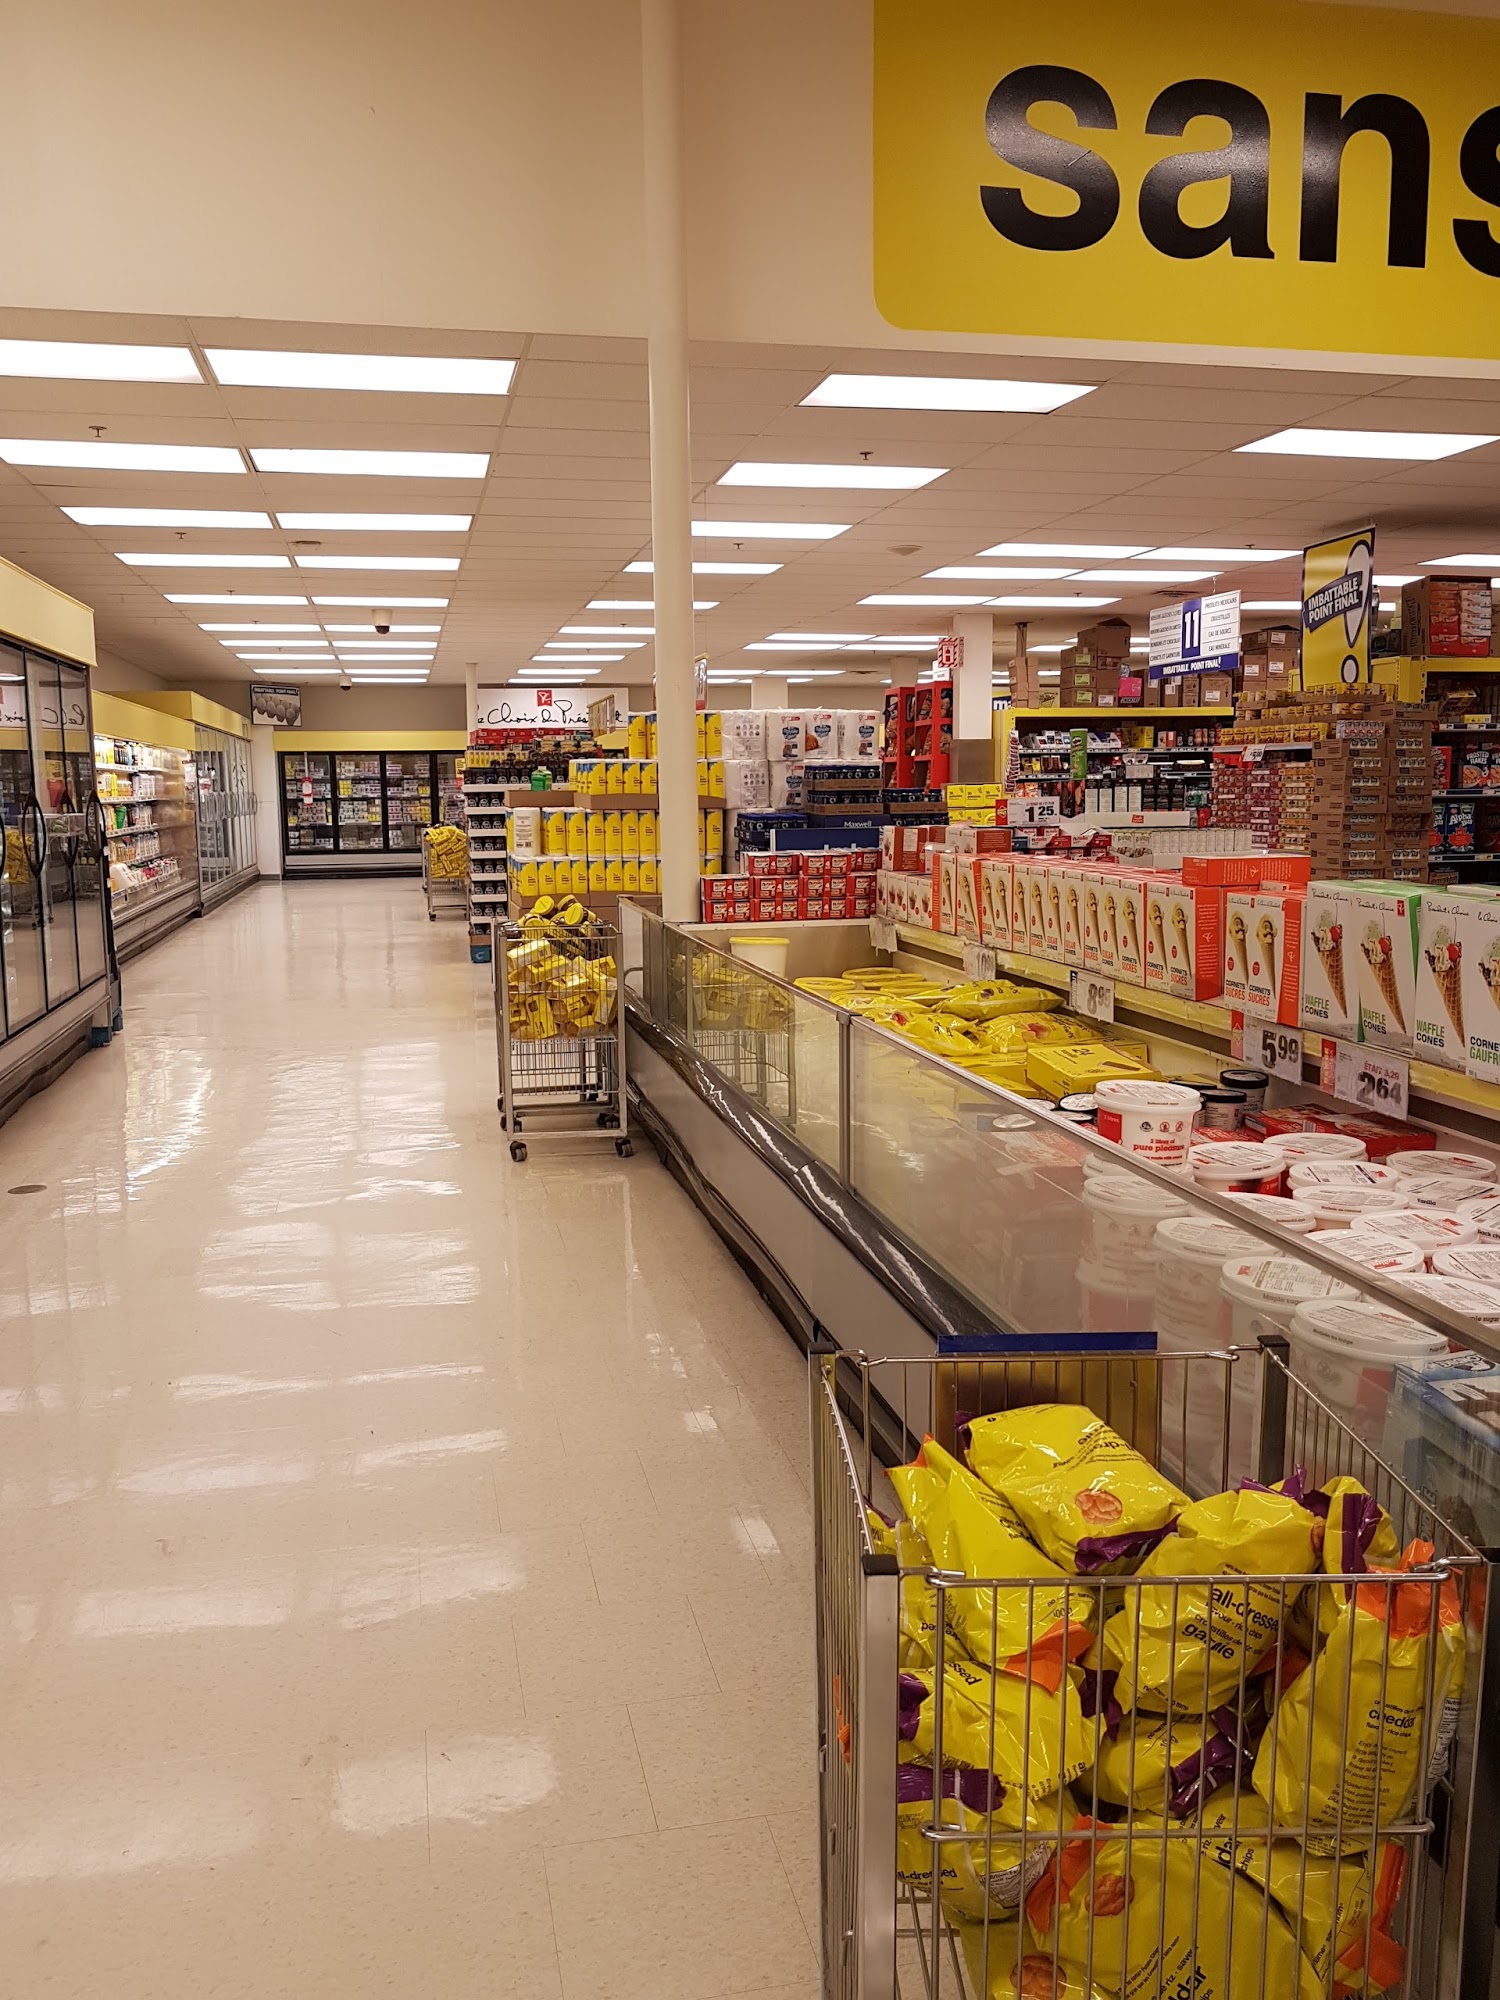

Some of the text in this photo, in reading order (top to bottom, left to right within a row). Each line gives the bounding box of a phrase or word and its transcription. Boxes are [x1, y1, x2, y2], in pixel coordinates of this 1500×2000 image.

[1308, 577, 1358, 611] IMBATTABLE
[1309, 591, 1359, 624] POINT FINAL
[1184, 609, 1200, 649] 11
[844, 820, 872, 828] Maxwell
[1122, 956, 1137, 964] CORNETS
[1147, 961, 1163, 970] CORNETS
[1171, 967, 1187, 976] CORNETS
[1226, 979, 1245, 989] CORNETS
[1249, 984, 1271, 995] CORNETS
[1305, 994, 1329, 1011] WAFFLE
[1305, 1006, 1328, 1018] CONES
[1363, 1008, 1386, 1025] WAFFLE
[1364, 1021, 1386, 1034] CONES
[1417, 1019, 1445, 1039] WAFFLE
[1416, 1033, 1445, 1048] CONES
[1417, 1198, 1436, 1206] Vanilla
[1263, 1293, 1282, 1304] Maple
